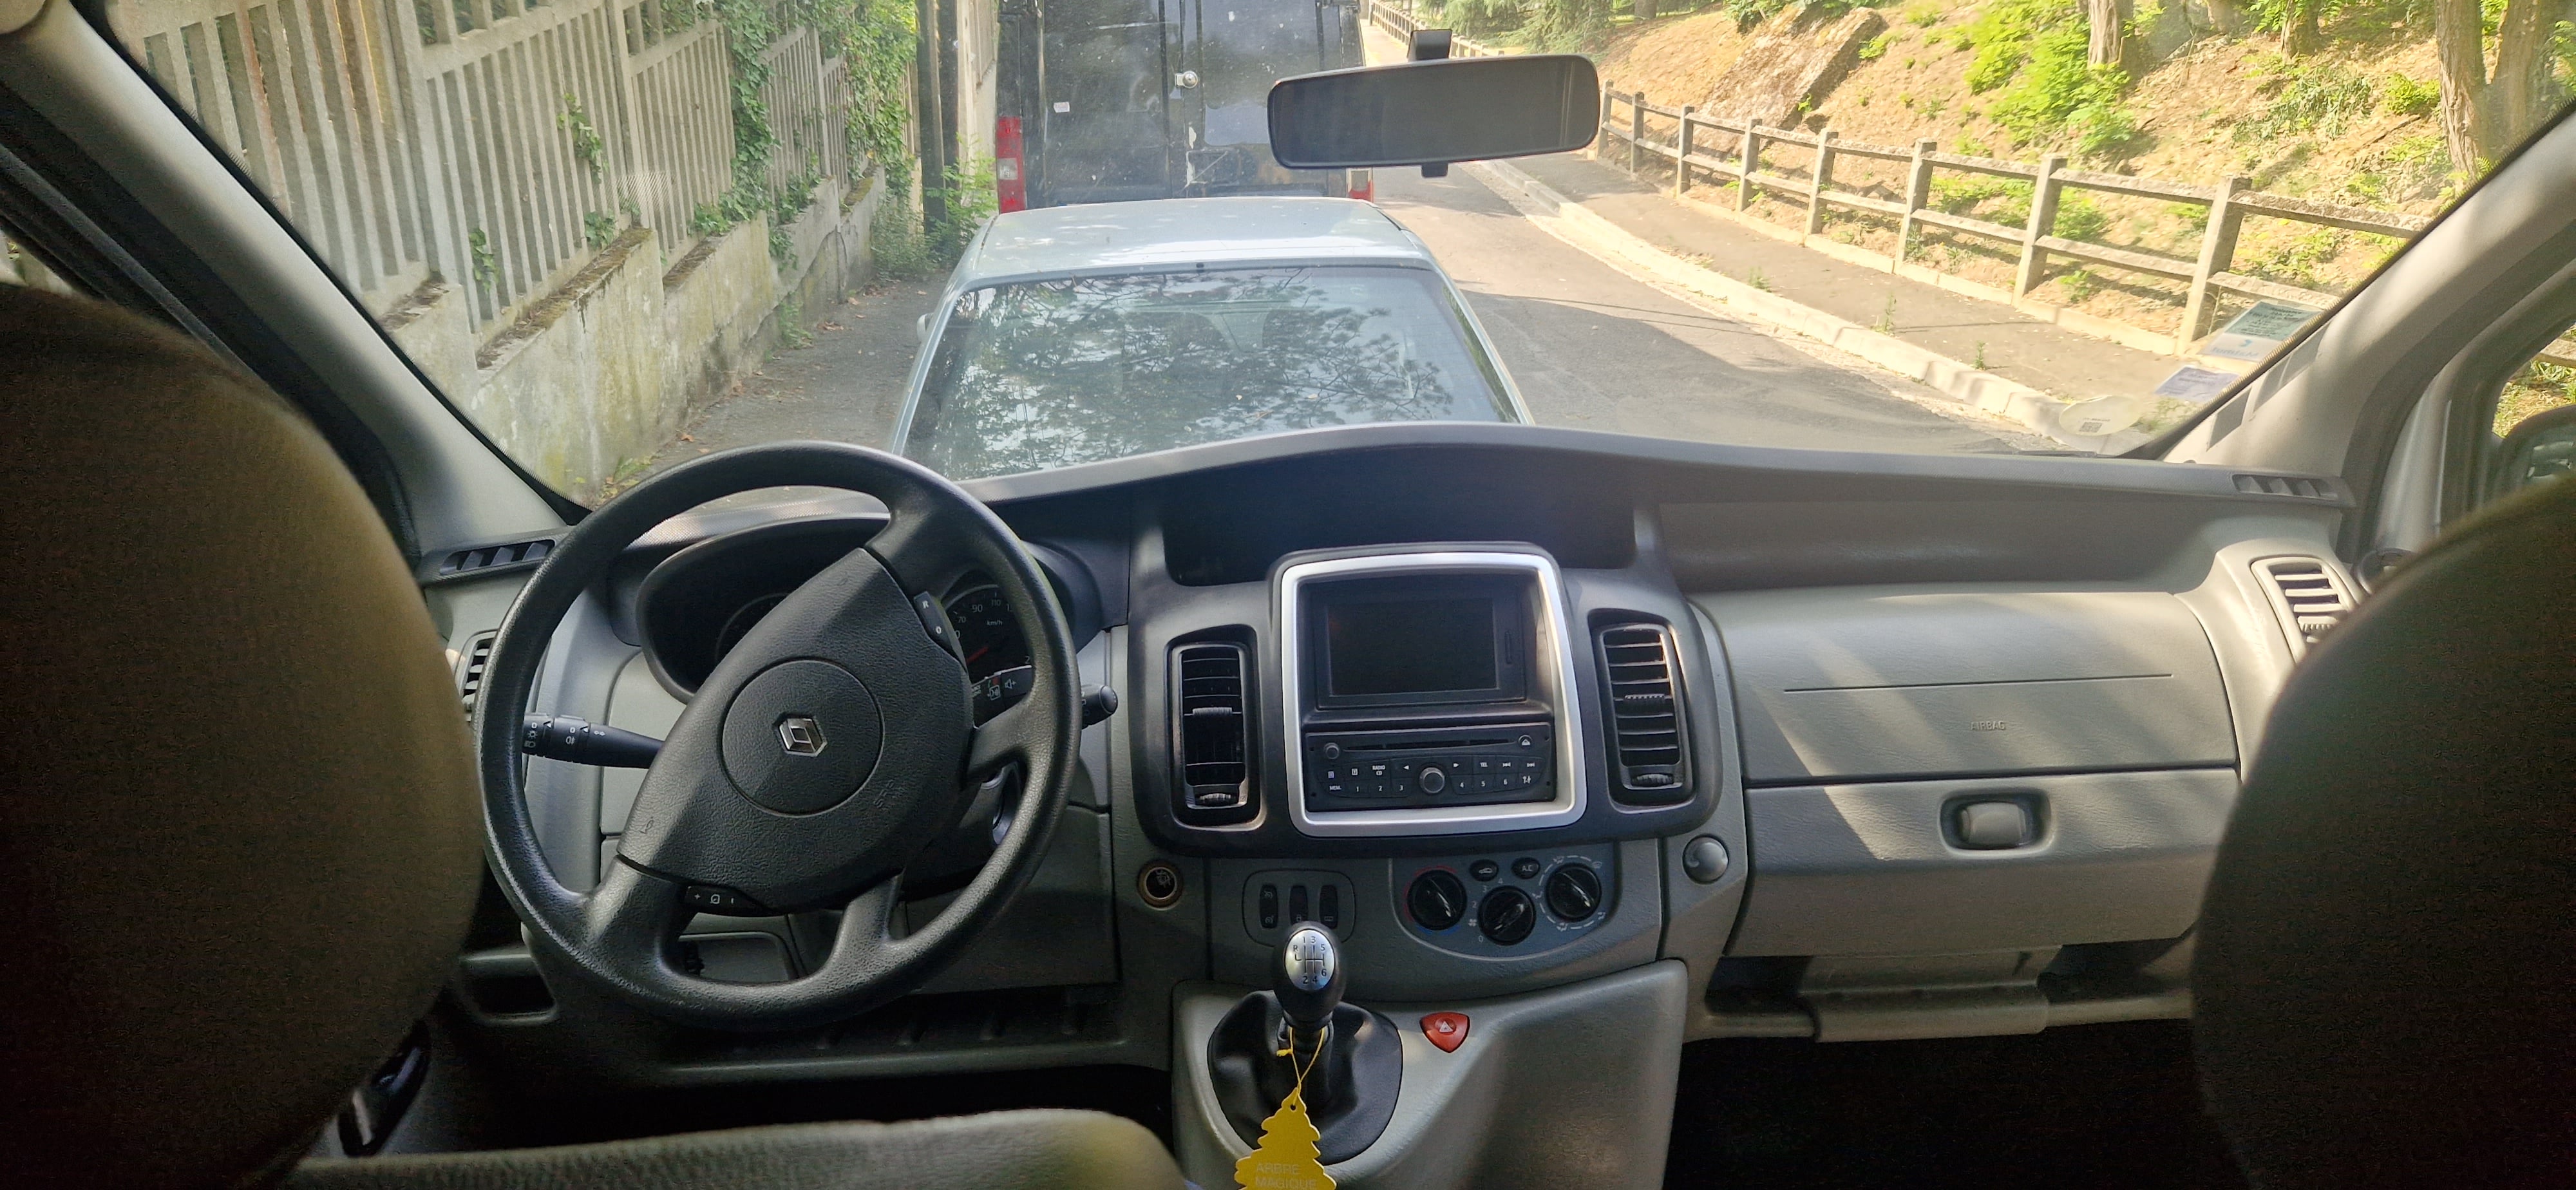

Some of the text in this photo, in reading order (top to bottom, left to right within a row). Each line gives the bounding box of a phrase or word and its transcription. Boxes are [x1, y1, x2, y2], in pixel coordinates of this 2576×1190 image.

[922, 600, 930, 609] R
[972, 604, 983, 613] 90
[1971, 721, 2005, 730] AIRBAG
[1472, 900, 1477, 909] 2
[1311, 936, 1316, 944] 3
[1320, 943, 1326, 952] 5
[1321, 968, 1327, 977] 6
[1303, 976, 1318, 985] 2 4
[1256, 1163, 1301, 1175] ARBRE
[1255, 1176, 1317, 1190] MAGIQUE
